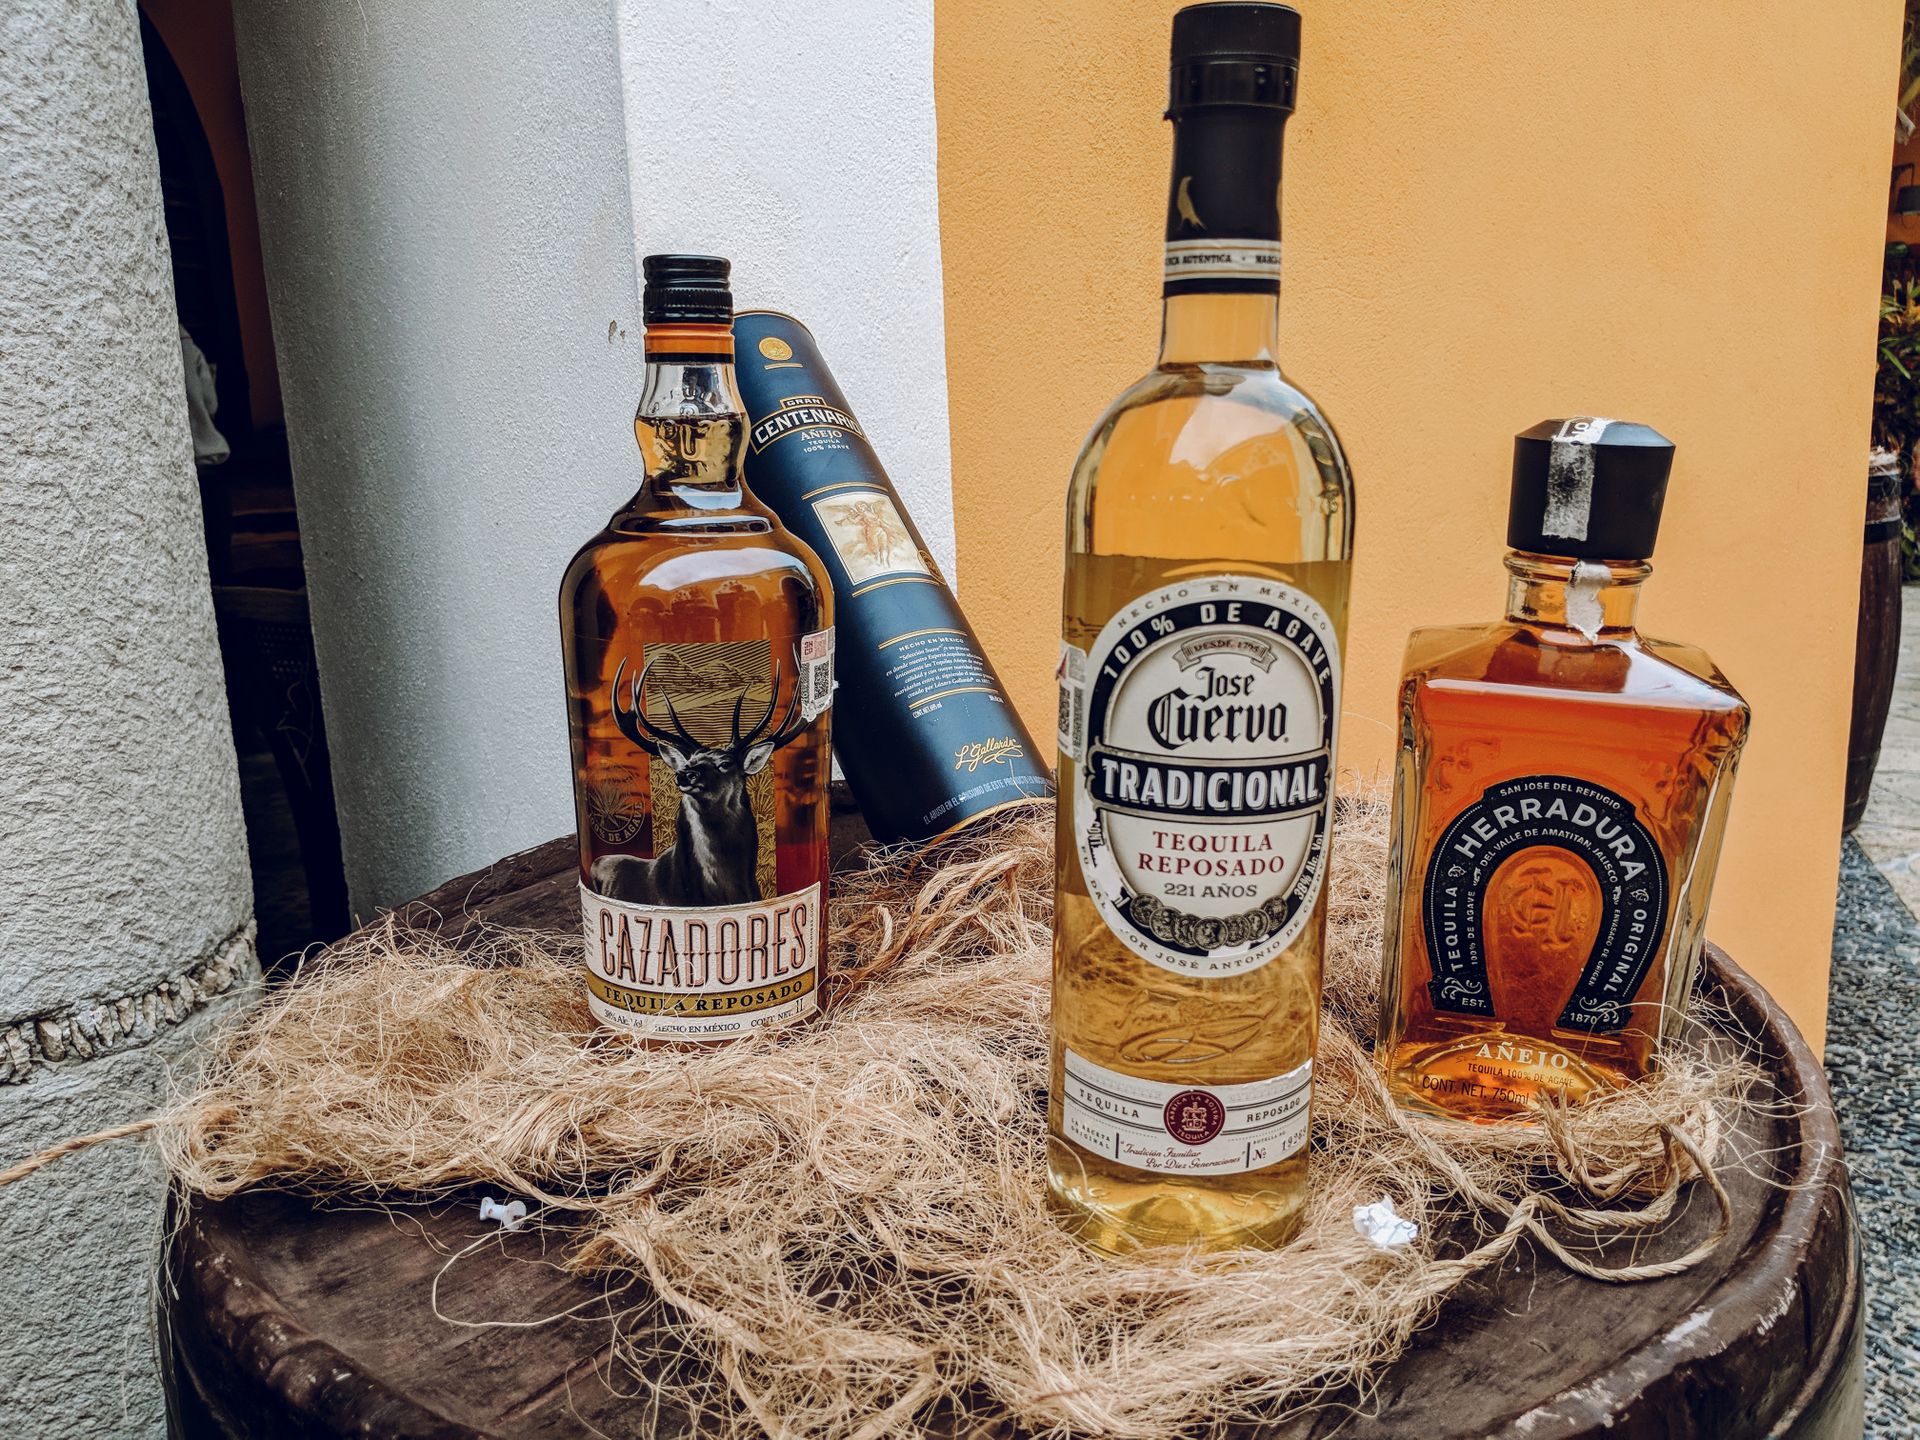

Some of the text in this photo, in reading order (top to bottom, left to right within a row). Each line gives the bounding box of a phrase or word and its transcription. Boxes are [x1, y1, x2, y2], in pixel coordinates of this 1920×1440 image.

[787, 398, 820, 406] GRAN
[755, 409, 863, 444] CENTENARIO
[801, 429, 842, 441] AÑEJO
[804, 444, 824, 453] 100%
[1117, 584, 1327, 632] HECHO EN MÉXICO
[899, 640, 925, 651] HECHO
[1103, 614, 1175, 680] 100%
[1200, 603, 1243, 623] DE
[1264, 609, 1331, 686] AGAVE
[1196, 666, 1256, 702] Jose
[1147, 686, 1286, 750] Cuervo
[1102, 758, 1320, 811] TRADICIONAL
[1499, 782, 1621, 811] SAN JOSE DEL REFUGIO
[929, 806, 946, 822] ABUSO
[1152, 831, 1272, 854] TEQUILA
[1454, 798, 1647, 882] HERRADURA
[1138, 852, 1285, 877] REPOSADO
[1293, 831, 1324, 900] 38% Alc. Vol.
[1479, 828, 1619, 883] DEL VALLE DE AMATITAN, JALISCO
[1163, 882, 1258, 898] 221 AÑOS
[1443, 886, 1464, 973] TEQUILA
[1467, 890, 1478, 965] 100% DE AGAVE
[600, 903, 807, 988] CAZADORES
[1155, 952, 1200, 969] JOSÉ
[1209, 941, 1280, 970] ANTONIO
[1286, 920, 1300, 937] DE
[1588, 908, 1621, 987] ENVASADO DE ORIGEN
[1603, 908, 1648, 993] ORIGINAL
[604, 981, 803, 1012] TEQUILA REPOSADO
[1461, 997, 1487, 1008] EST.
[703, 1022, 740, 1033] MÉXICO
[1570, 1012, 1597, 1025] 1870
[1475, 1041, 1569, 1070] AÑEJO
[1467, 1062, 1574, 1087] TEQUILA 100% DE AGAVE
[1079, 1088, 1140, 1119] TEQUILA
[1422, 1076, 1457, 1094] CONT.
[1461, 1083, 1488, 1099] NET.
[1491, 1086, 1530, 1105] 750ml
[1246, 1097, 1301, 1123] REPOSADO
[1177, 1128, 1210, 1140] TEQUILA
[1145, 1157, 1162, 1168] Por
[1163, 1159, 1187, 1169] Diez
[1163, 1146, 1202, 1158] Familiar
